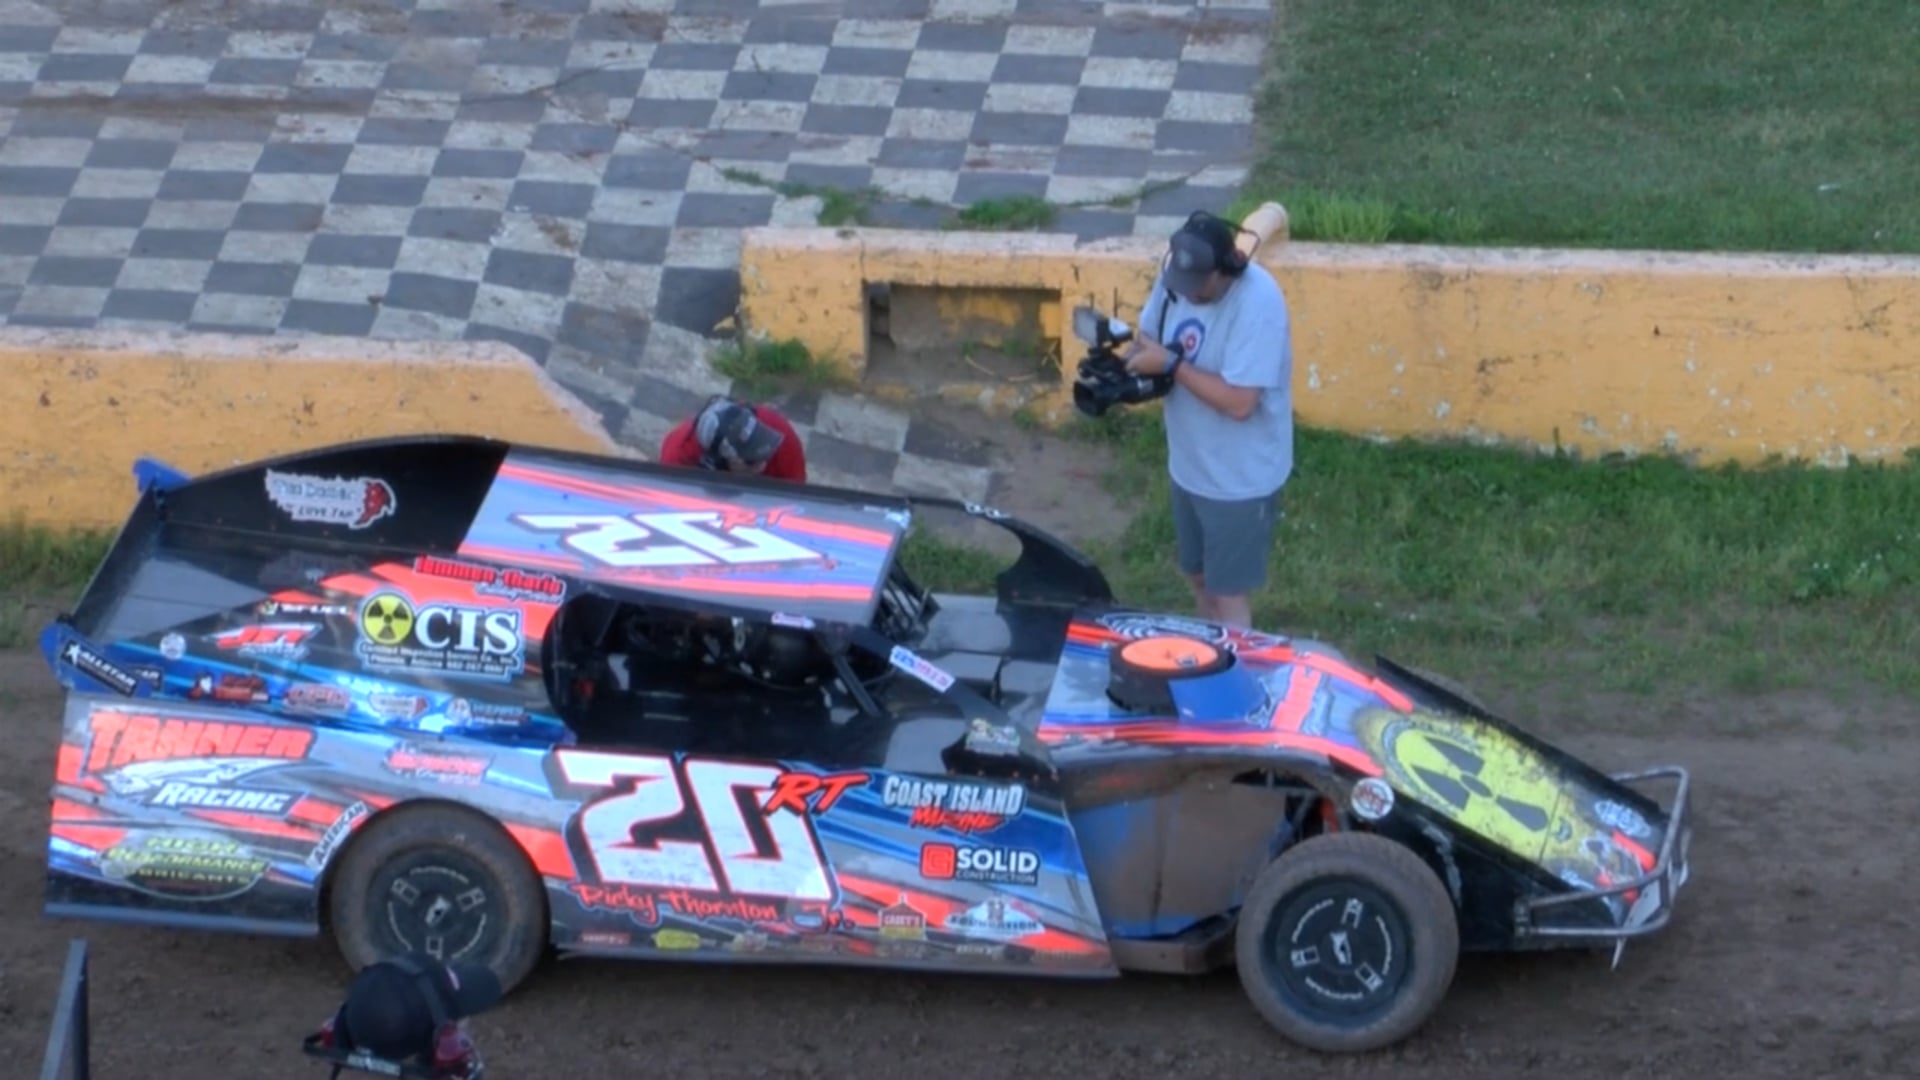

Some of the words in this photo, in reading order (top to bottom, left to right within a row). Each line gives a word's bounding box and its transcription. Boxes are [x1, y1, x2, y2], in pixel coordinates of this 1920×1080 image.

[515, 512, 822, 566] 20
[415, 606, 518, 655] CIS
[80, 650, 137, 686] ALLSTAR
[87, 711, 314, 772] TANNER
[149, 781, 292, 812] RACING
[883, 775, 949, 808] COAST
[951, 783, 1024, 816] ISLAND
[313, 804, 365, 866] AMERICAN
[556, 750, 832, 899] 20
[765, 772, 871, 814] RT
[106, 848, 266, 872] PERFORMANCE
[956, 871, 1036, 884] CONSTRUCTION
[957, 847, 1038, 873] SOLID
[570, 883, 658, 924] Ricky
[659, 890, 779, 921] Thornton
